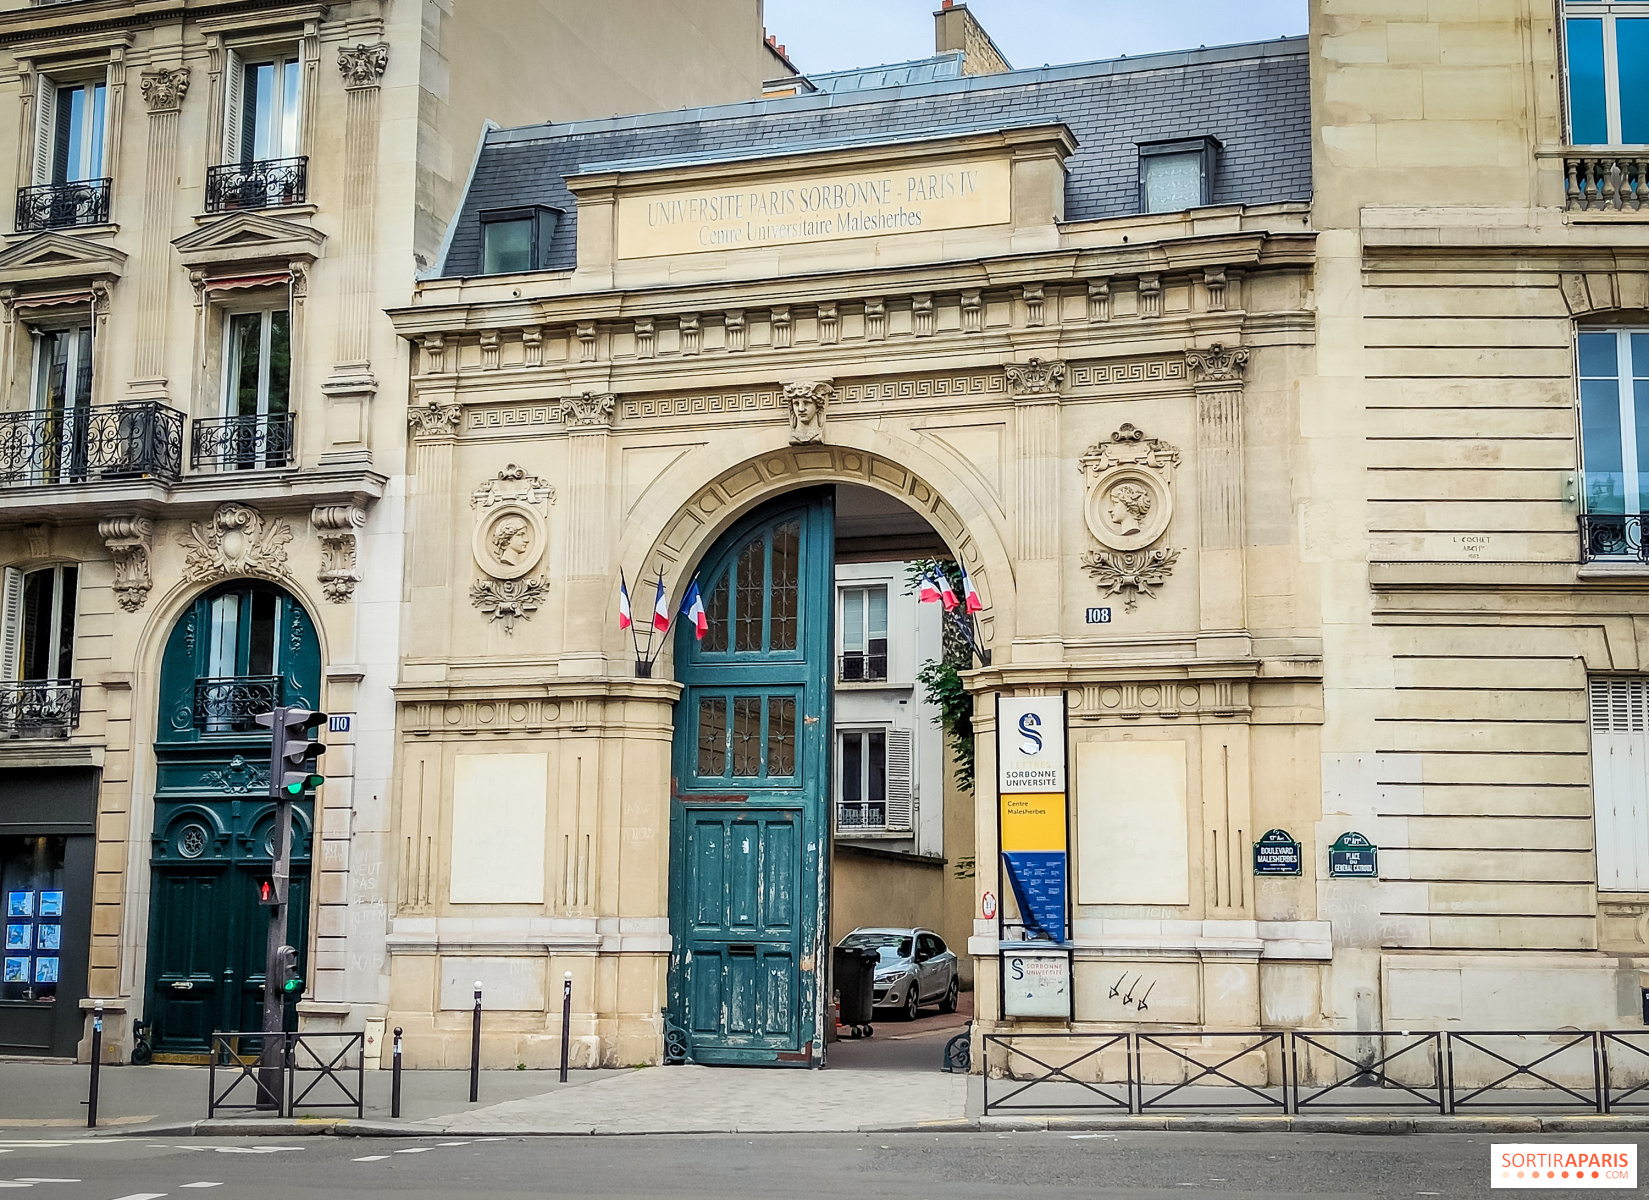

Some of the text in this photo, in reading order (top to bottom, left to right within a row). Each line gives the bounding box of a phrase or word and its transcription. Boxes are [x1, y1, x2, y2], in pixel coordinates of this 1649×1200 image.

[648, 194, 744, 227] UNIVERSITE
[750, 189, 795, 216] PARIS
[800, 179, 892, 213] SORBONNE
[907, 172, 955, 202] PARIS
[960, 171, 978, 196] IV
[699, 206, 922, 246] Centre Universitaire Malesherbes
[1088, 608, 1110, 622] 108
[331, 717, 348, 731] 110
[1006, 770, 1057, 779] SORBONNE
[1006, 777, 1057, 787] UNIVERSITÉ
[1260, 847, 1294, 855] BOULEVARD
[1345, 852, 1360, 860] PLACE
[1257, 855, 1298, 863] MALESHERBES
